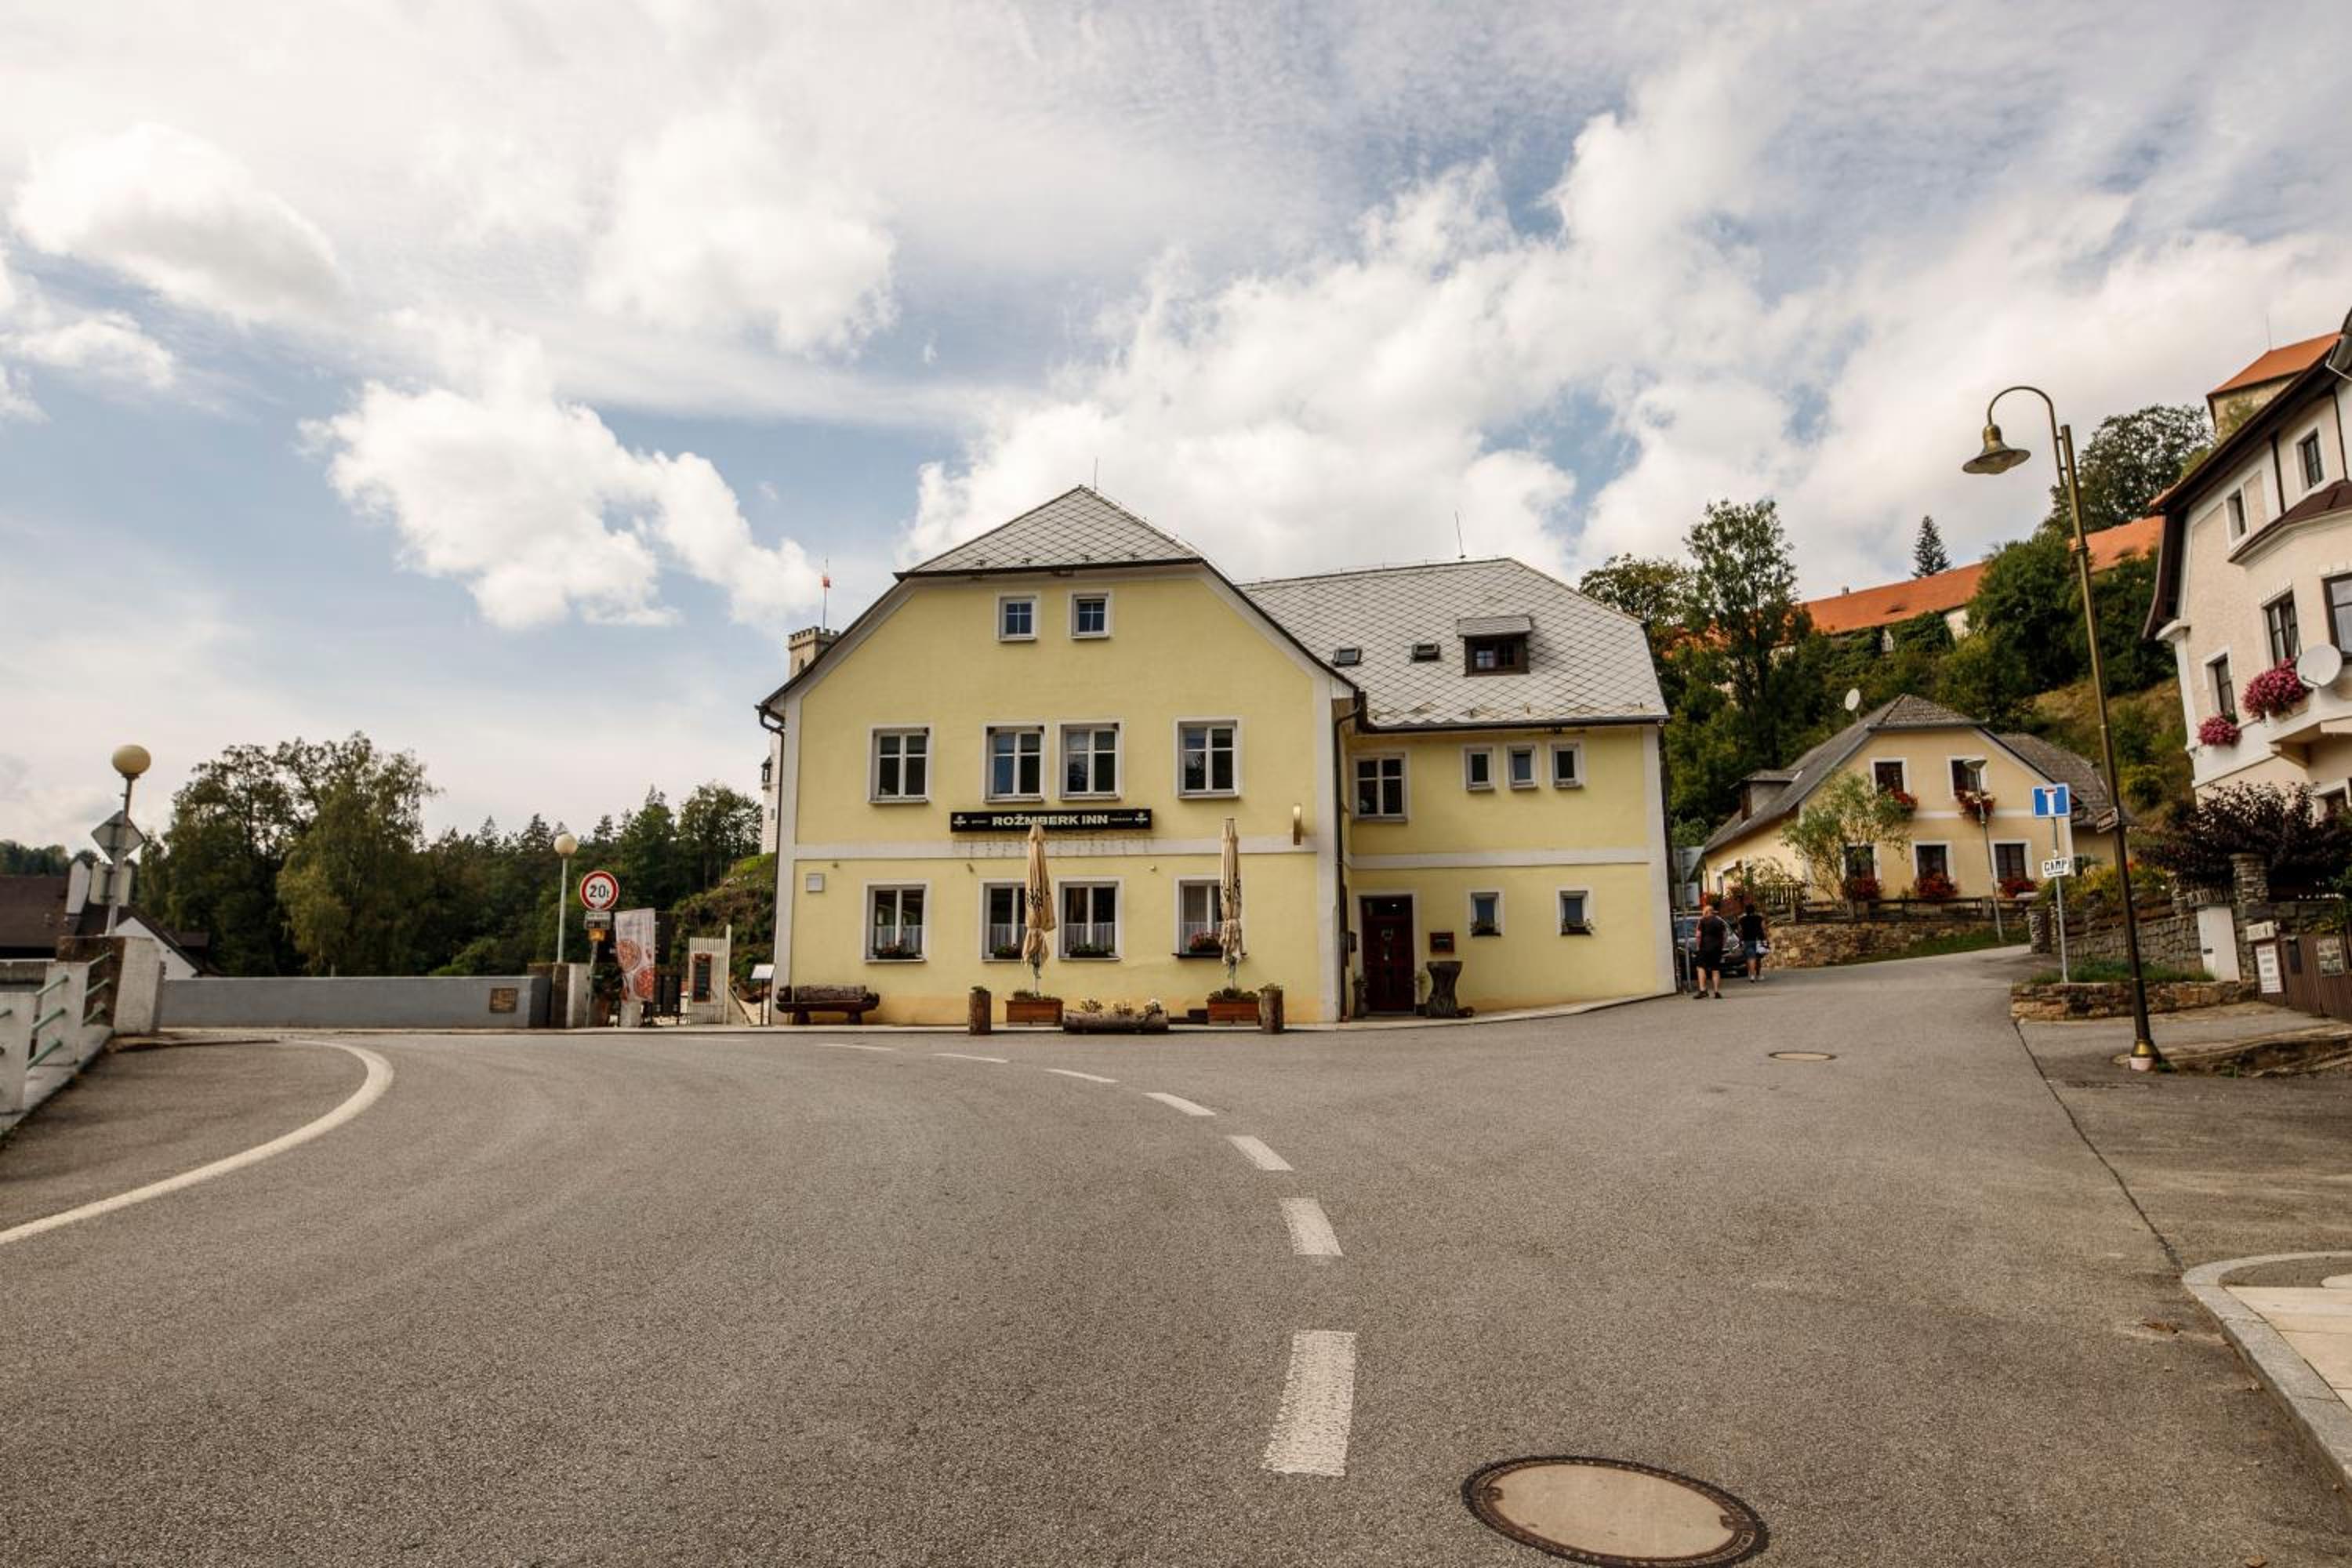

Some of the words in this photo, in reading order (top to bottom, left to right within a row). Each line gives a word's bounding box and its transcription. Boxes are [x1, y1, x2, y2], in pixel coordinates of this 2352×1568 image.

[992, 813, 1080, 826] ROŽMBERK
[1081, 815, 1109, 825] INN
[2044, 859, 2067, 872] CAMP
